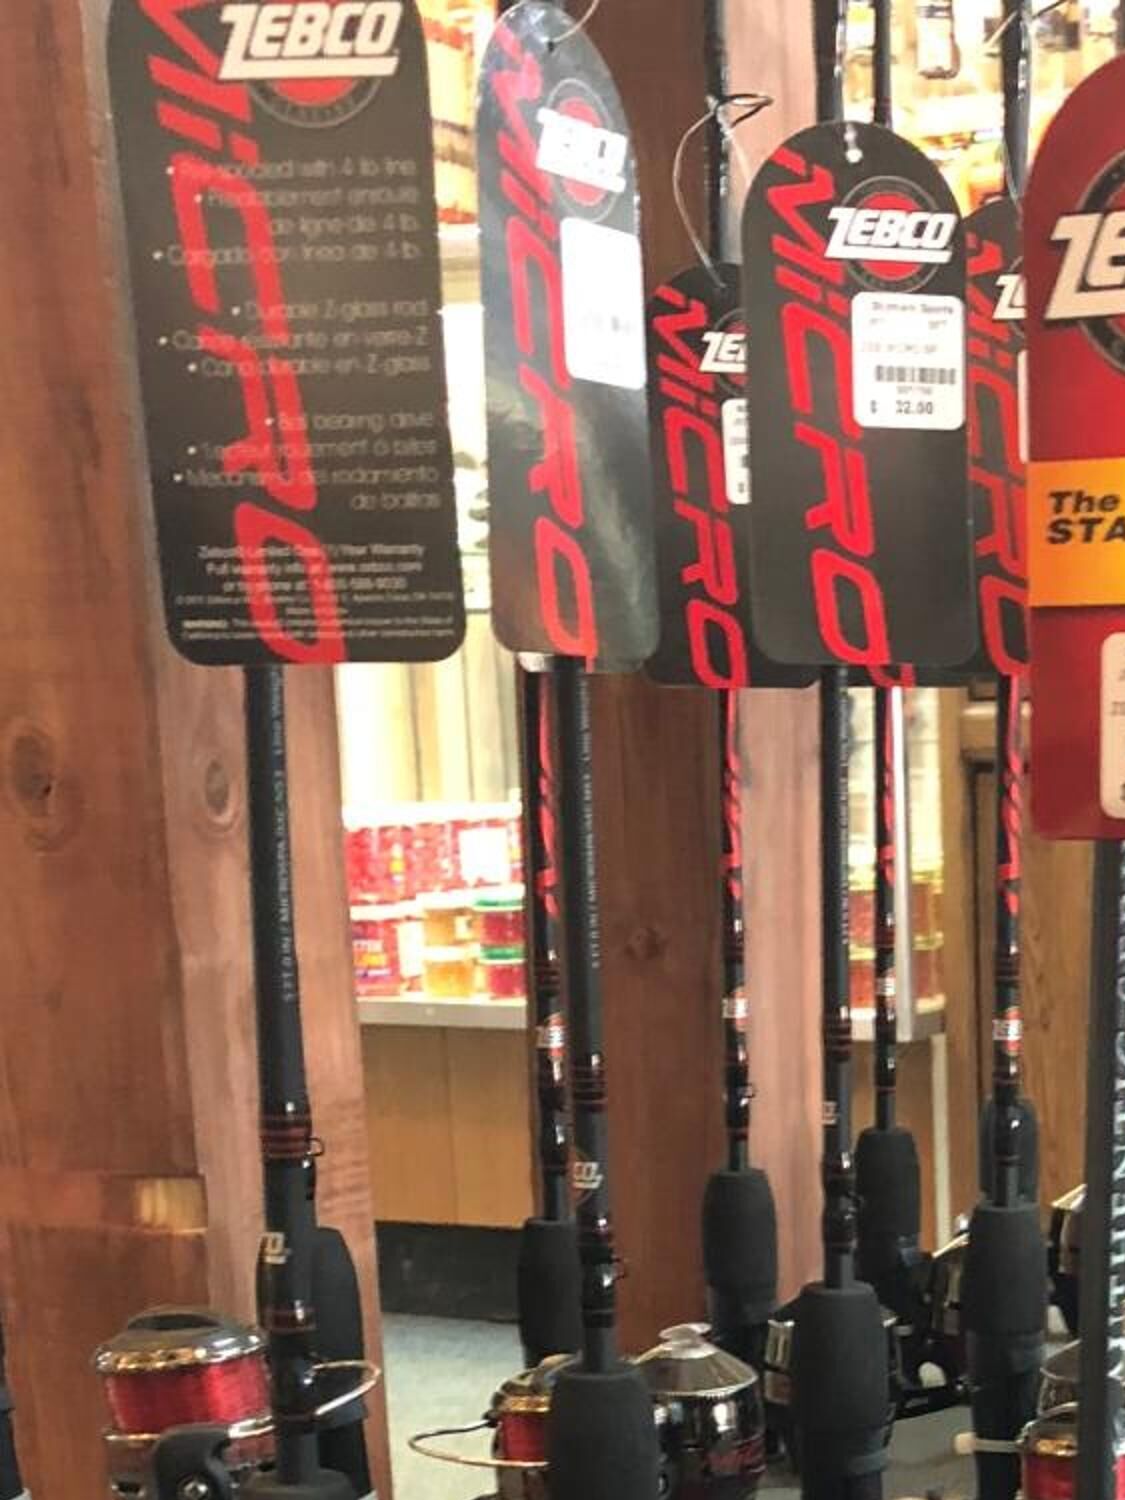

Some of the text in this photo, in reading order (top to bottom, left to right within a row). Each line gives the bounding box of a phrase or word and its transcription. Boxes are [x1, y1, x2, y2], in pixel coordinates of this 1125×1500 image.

[218, 1, 404, 80] ZEBCO
[825, 206, 959, 264] ZEBCO
[1047, 489, 1121, 514] The
